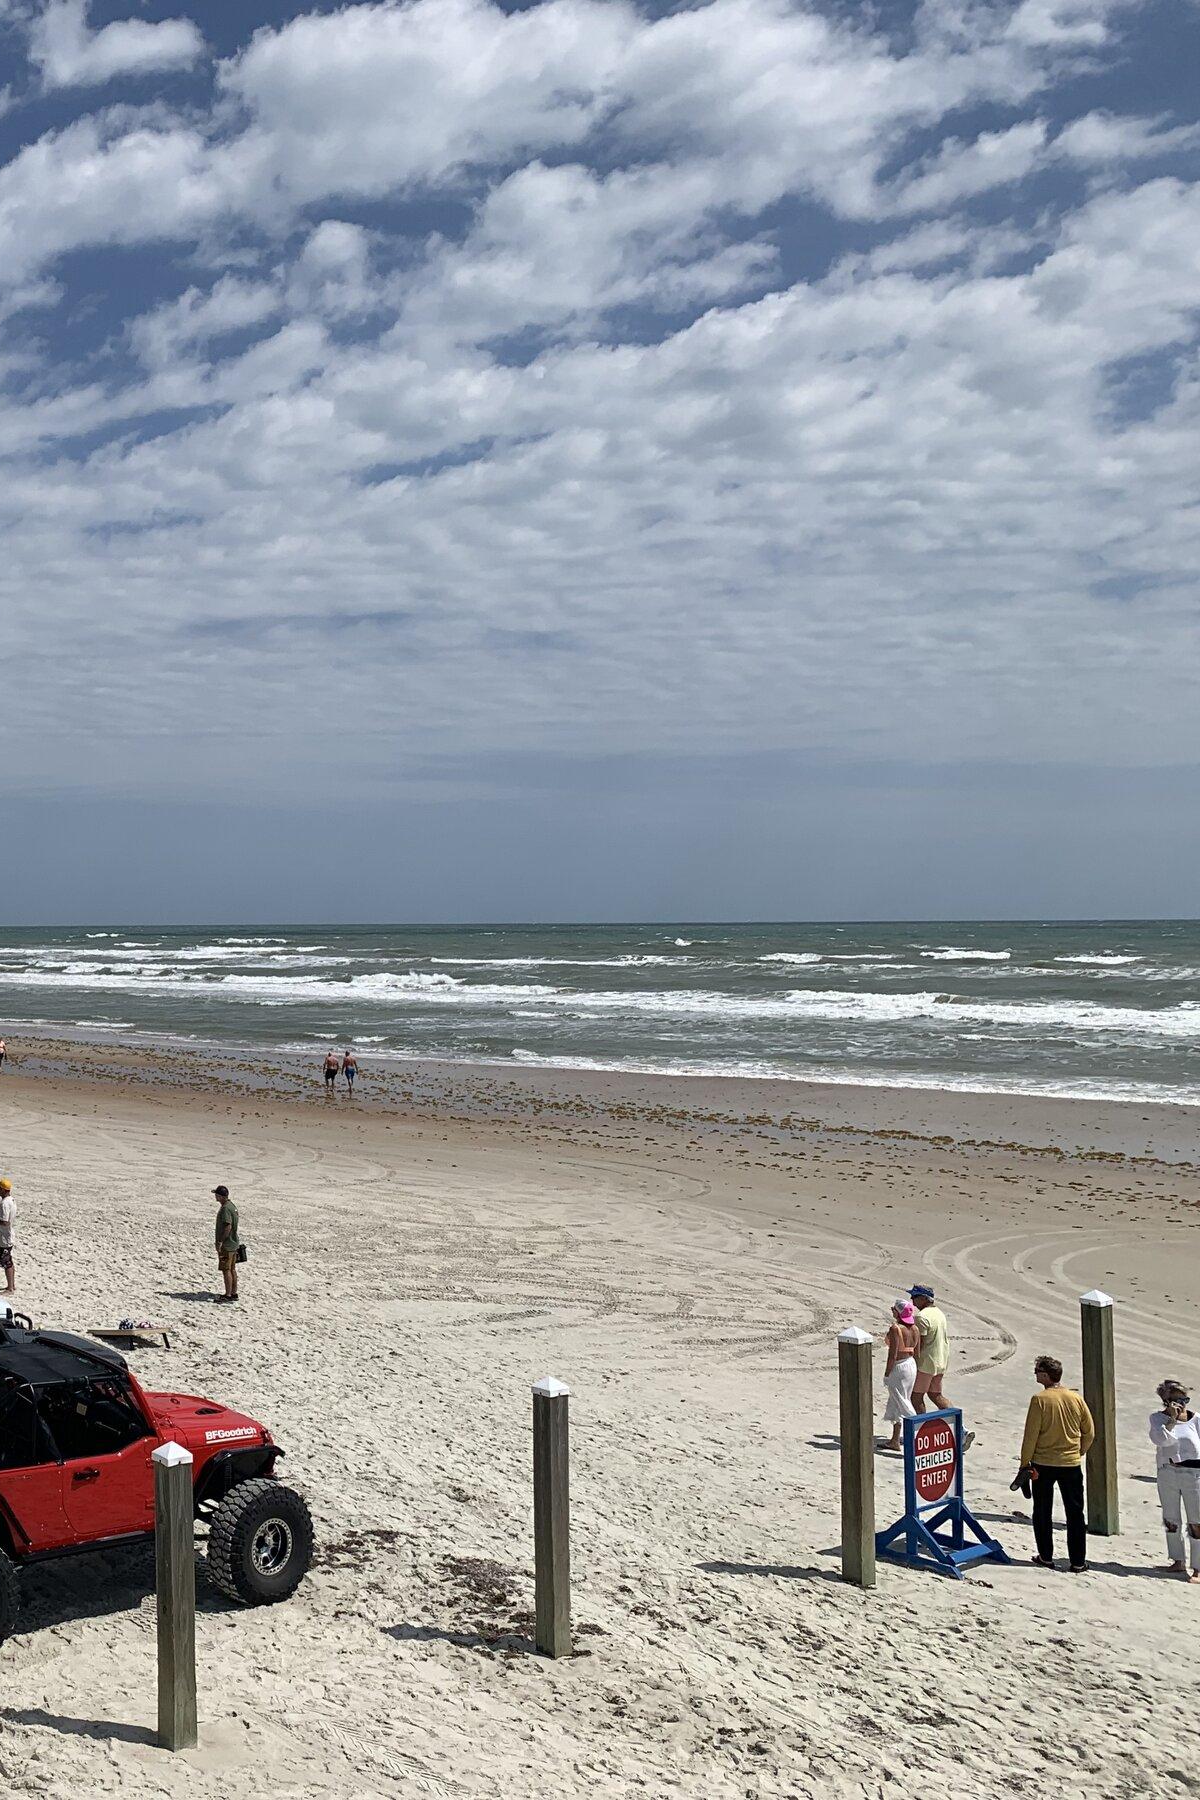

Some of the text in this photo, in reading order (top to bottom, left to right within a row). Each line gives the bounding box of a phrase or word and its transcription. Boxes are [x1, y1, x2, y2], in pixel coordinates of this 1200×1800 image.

[205, 1427, 257, 1441] BFGoodrich
[918, 1431, 950, 1451] DO NOT
[915, 1450, 953, 1471] VEHICLES
[921, 1469, 948, 1488] ENTER
